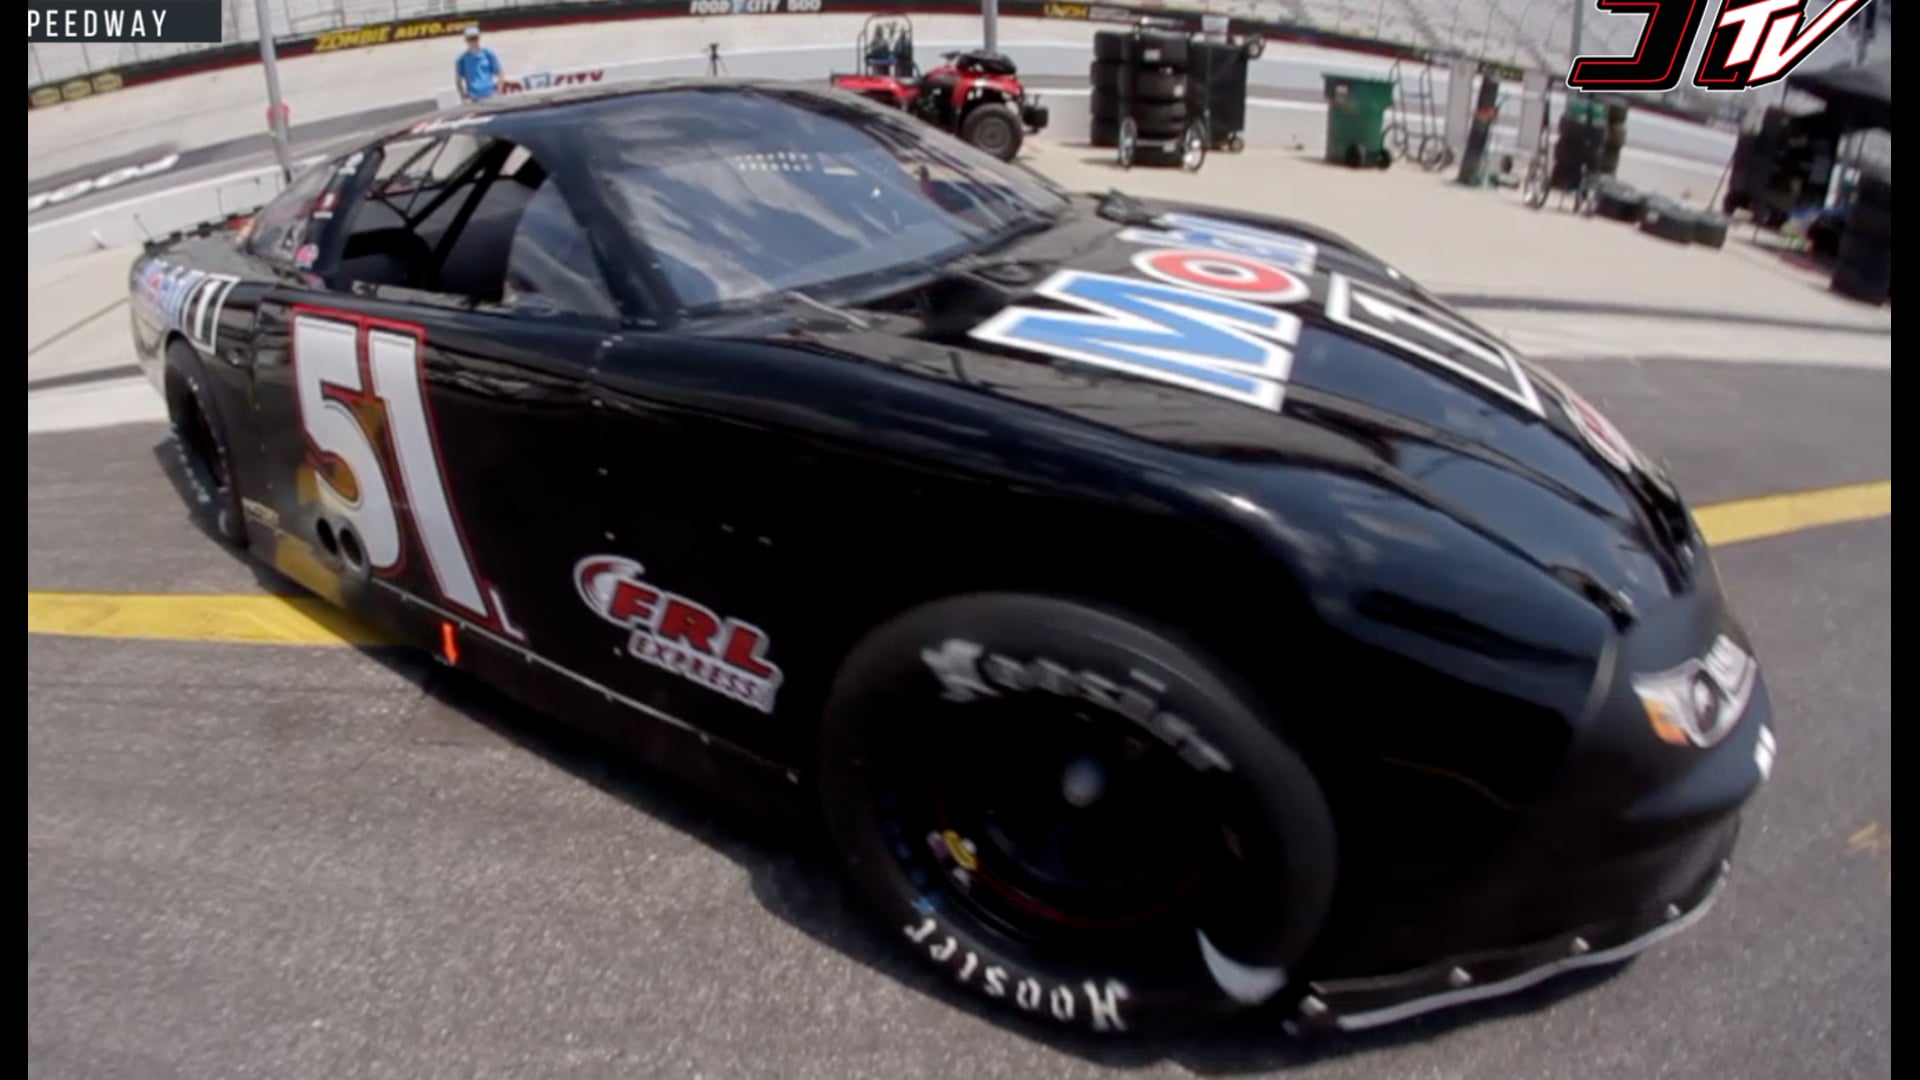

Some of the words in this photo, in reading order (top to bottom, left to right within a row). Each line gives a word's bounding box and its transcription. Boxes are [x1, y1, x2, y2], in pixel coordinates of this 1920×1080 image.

[290, 305, 500, 631] 51
[606, 576, 778, 681] FRL
[634, 634, 760, 701] EXPRESS
